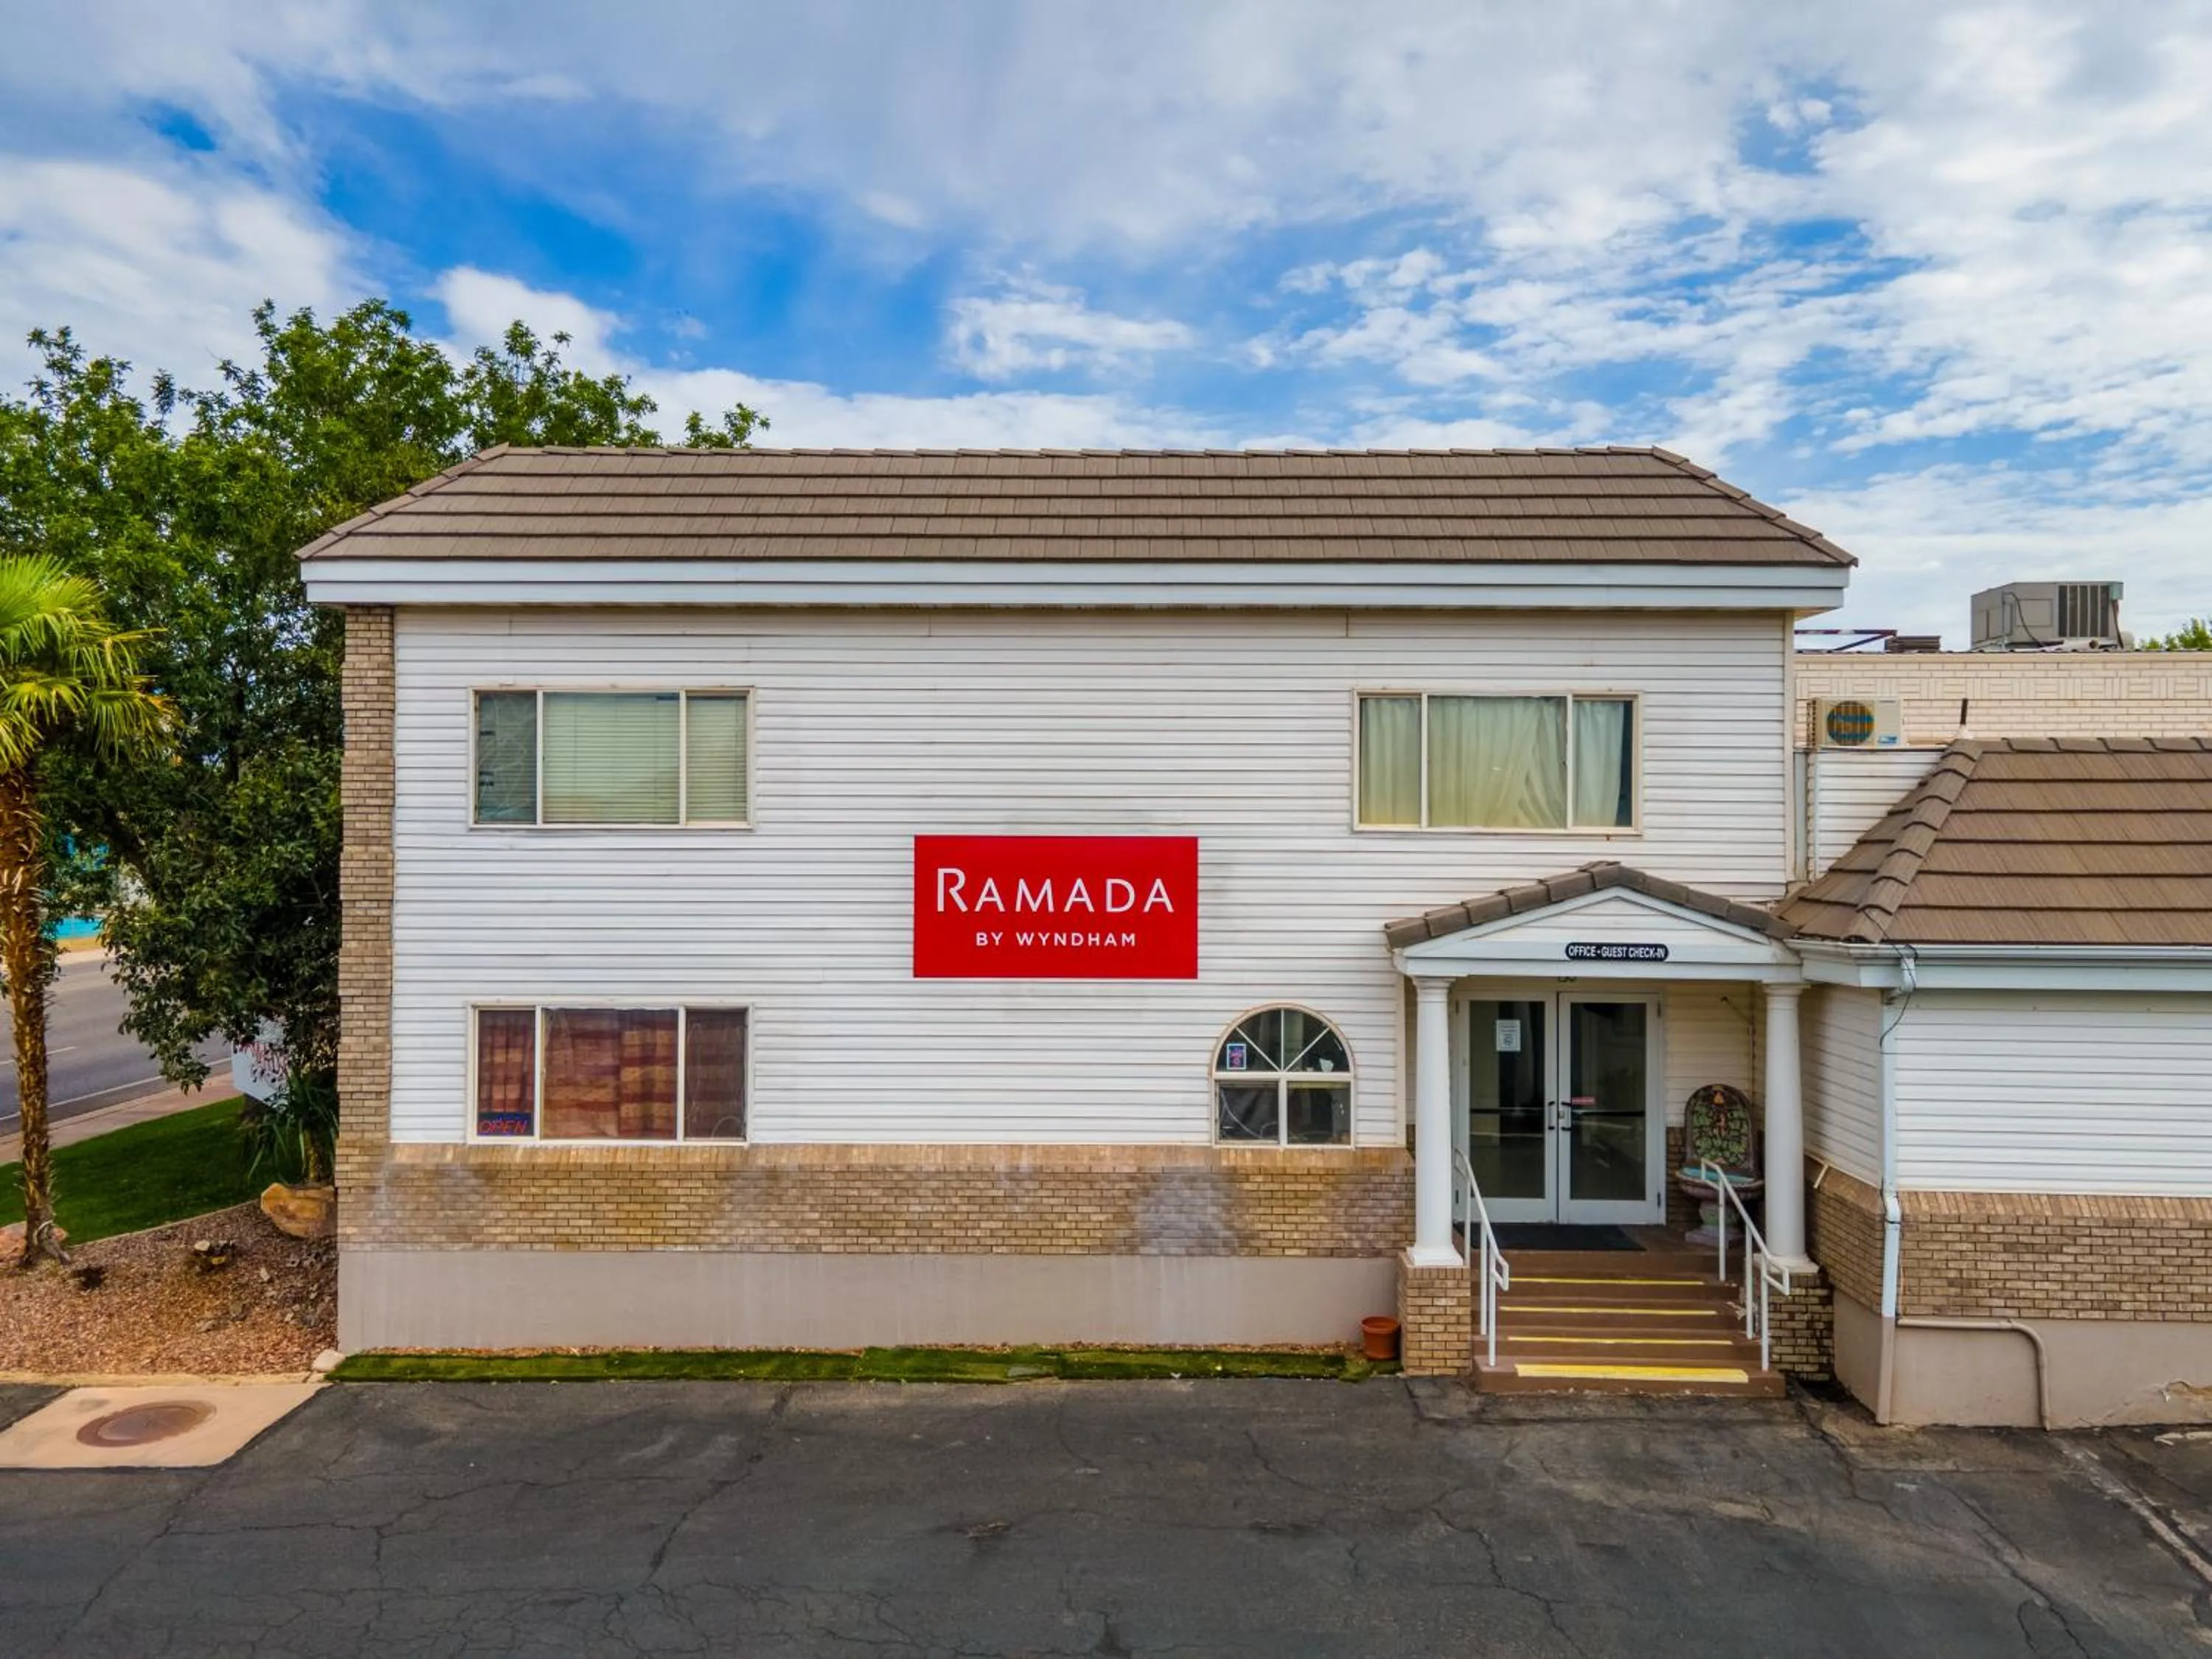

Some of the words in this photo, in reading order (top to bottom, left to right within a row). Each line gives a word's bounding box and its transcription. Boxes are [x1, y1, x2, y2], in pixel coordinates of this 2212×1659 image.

[936, 867, 1174, 913] RAMADA
[976, 932, 1003, 946] BY
[1015, 932, 1135, 946] WYNDHAM
[1568, 945, 1596, 956] OFFICE
[1601, 946, 1627, 958] GUEST
[1628, 947, 1665, 958] CHECK-IN
